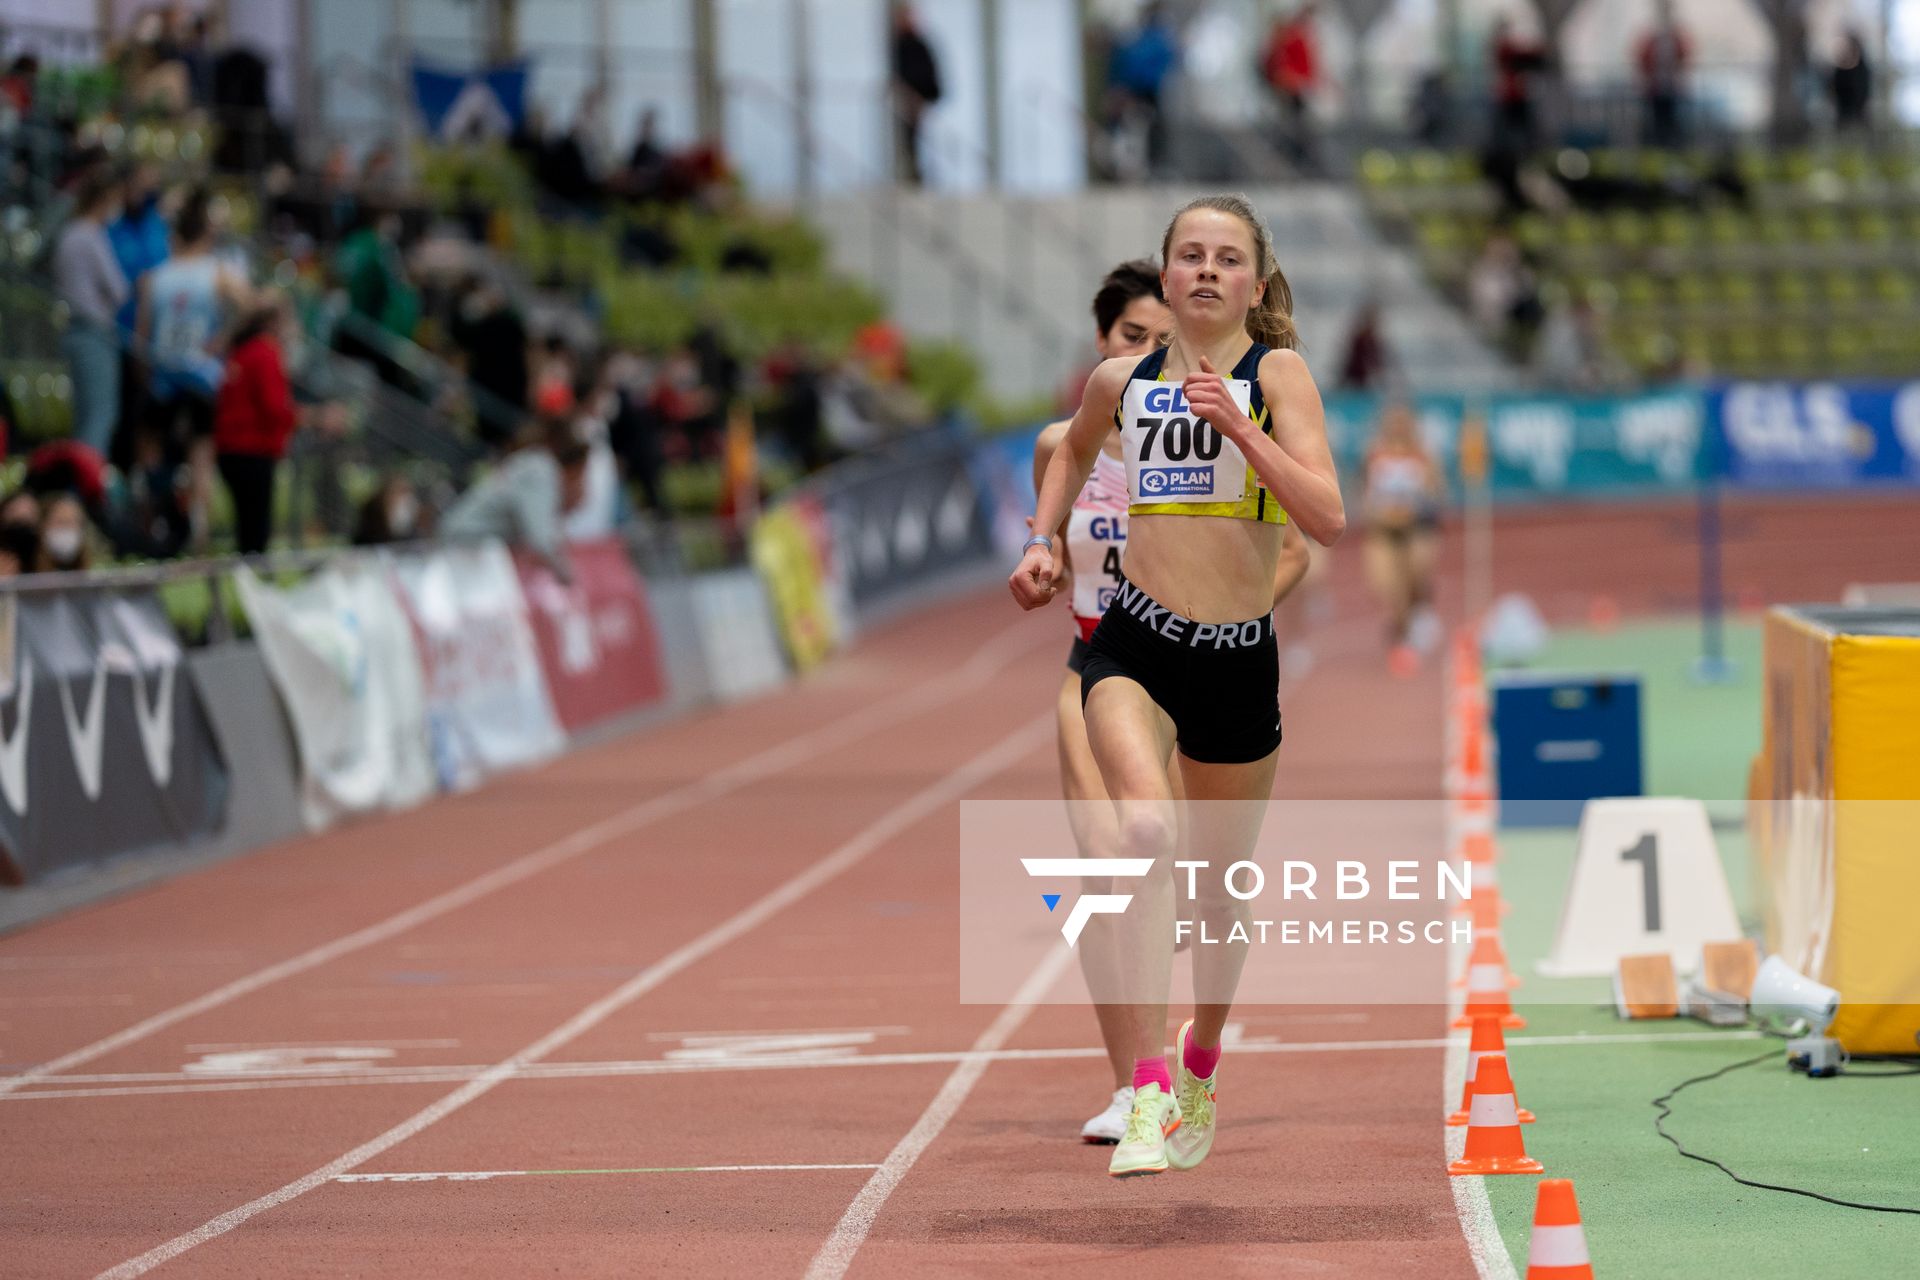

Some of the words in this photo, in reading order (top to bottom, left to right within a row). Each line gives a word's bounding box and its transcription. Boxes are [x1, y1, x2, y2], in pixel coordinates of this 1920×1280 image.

[1145, 387, 1191, 414] GL
[1137, 417, 1222, 462] 700
[1170, 472, 1211, 485] PLAN
[1090, 516, 1127, 541] GL
[1116, 580, 1190, 643] NIKE
[1190, 619, 1262, 650] PRO
[1620, 831, 1661, 932] 1
